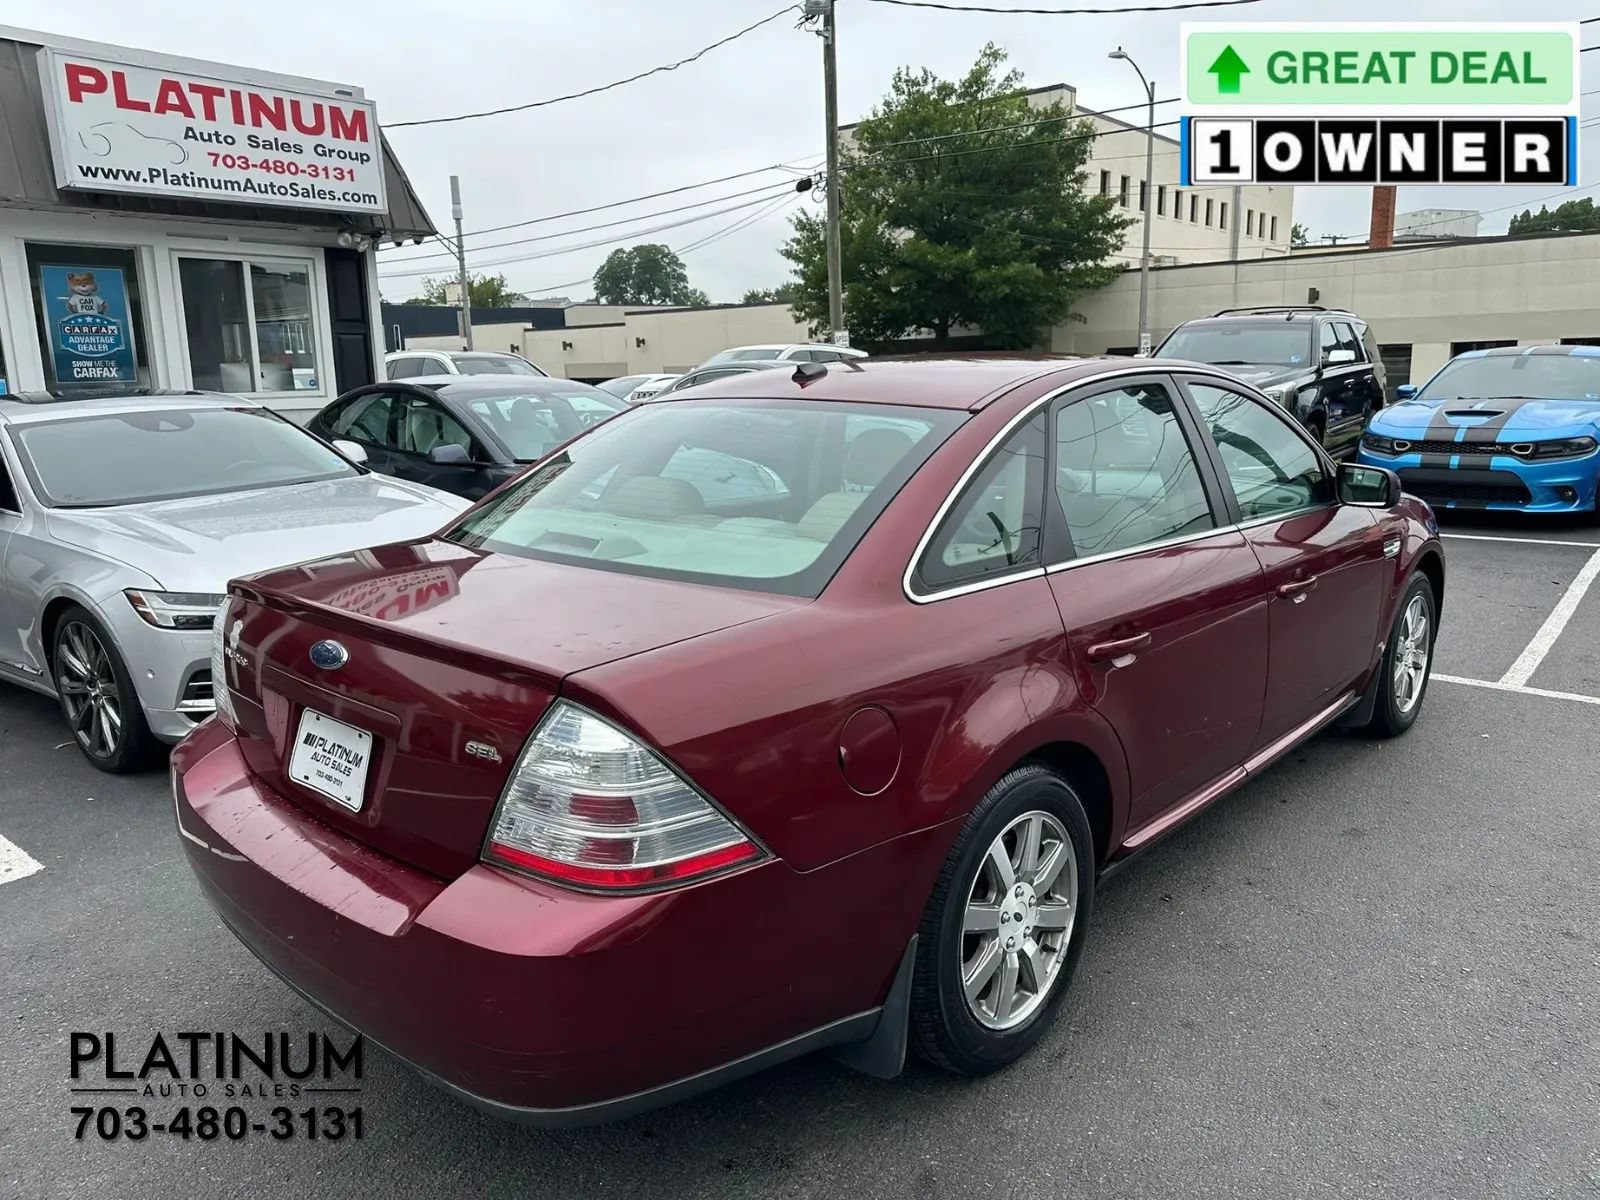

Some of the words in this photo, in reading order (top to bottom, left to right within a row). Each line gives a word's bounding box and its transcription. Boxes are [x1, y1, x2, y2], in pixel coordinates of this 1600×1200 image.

[64, 62, 369, 143] PLATINUM
[183, 126, 236, 146] Auto
[247, 134, 304, 155] Sales
[313, 144, 371, 165] Group
[207, 151, 356, 183] 703-480-3131
[78, 164, 378, 205] www.PlatinumAutoSales.com
[64, 326, 117, 335] CARFAX
[69, 336, 115, 344] ADVANTAGE
[78, 344, 109, 352] DEALER
[72, 360, 93, 368] SHOW
[73, 367, 118, 378] CARFAX
[311, 752, 332, 766] AUTO
[331, 760, 352, 777] SALES
[314, 736, 364, 768] PLATINUM
